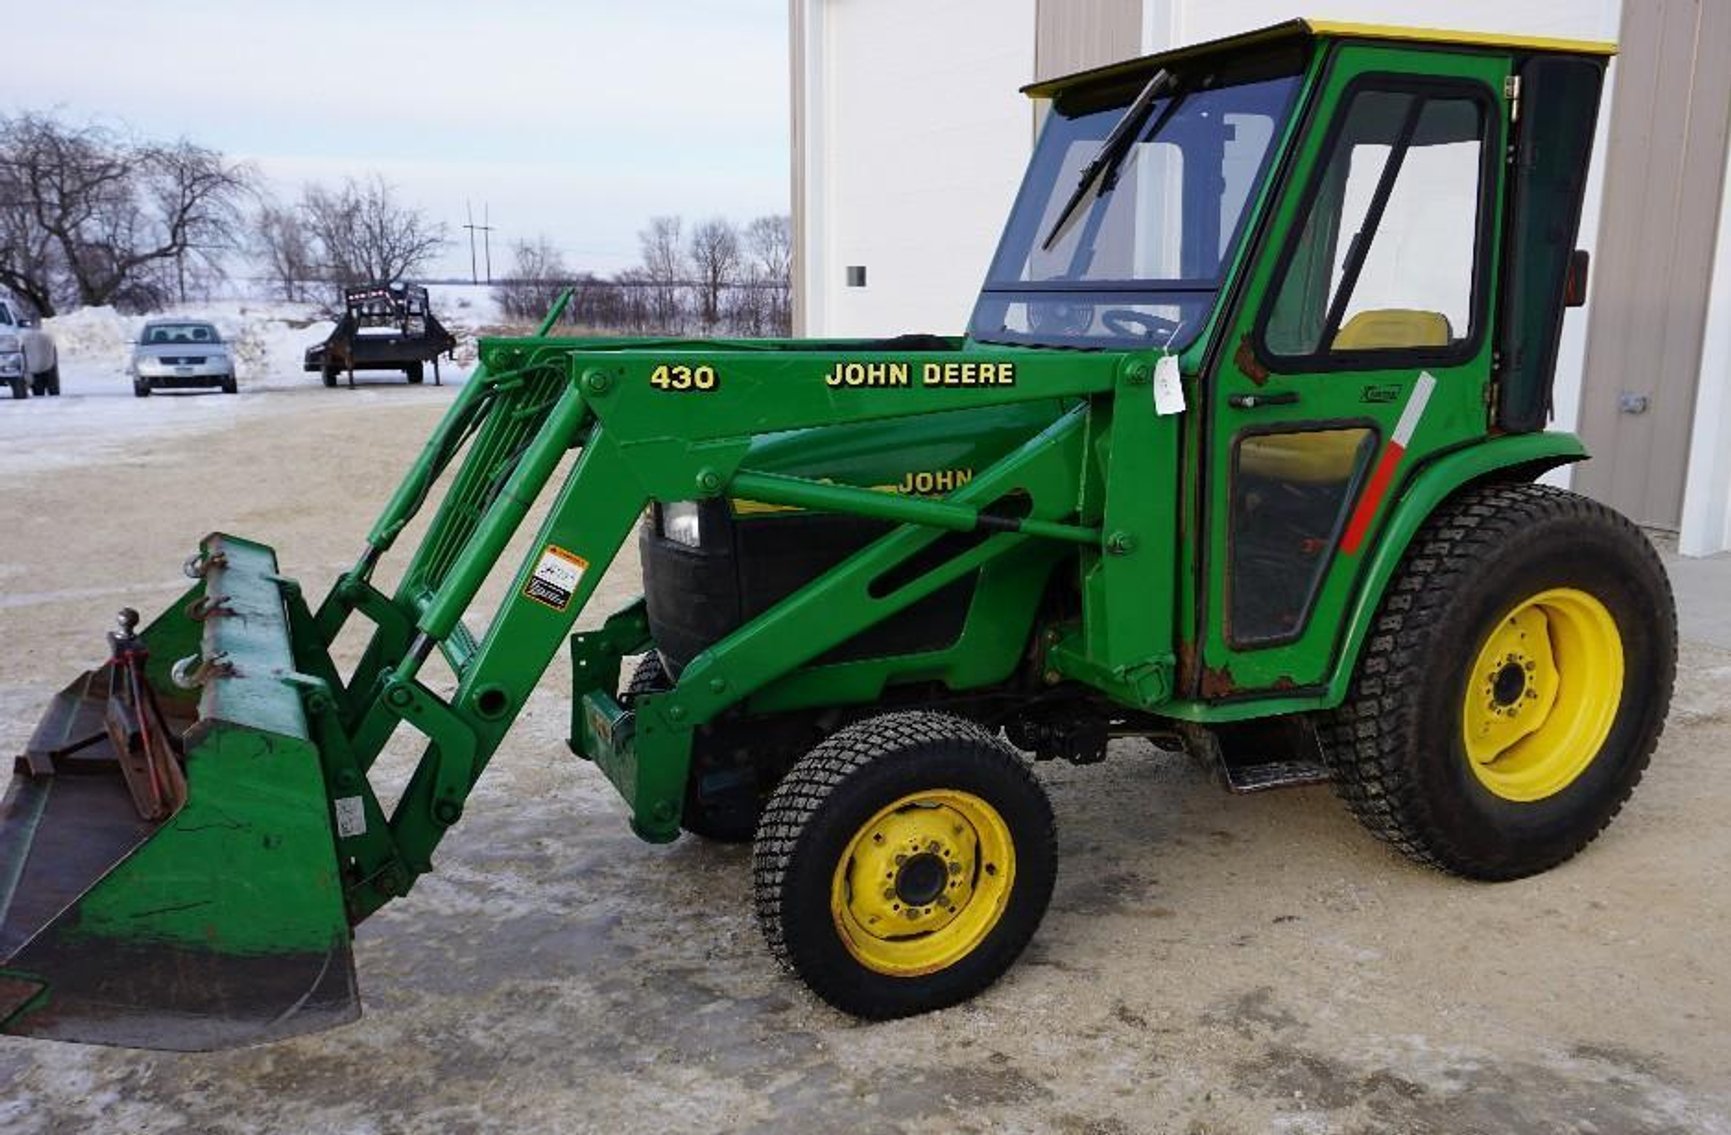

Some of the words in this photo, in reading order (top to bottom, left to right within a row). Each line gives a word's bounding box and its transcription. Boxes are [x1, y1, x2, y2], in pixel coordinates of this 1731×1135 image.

[651, 365, 716, 390] 430
[825, 363, 910, 386] JOHN
[922, 363, 1014, 385] DEERE
[899, 469, 973, 493] JOHN
